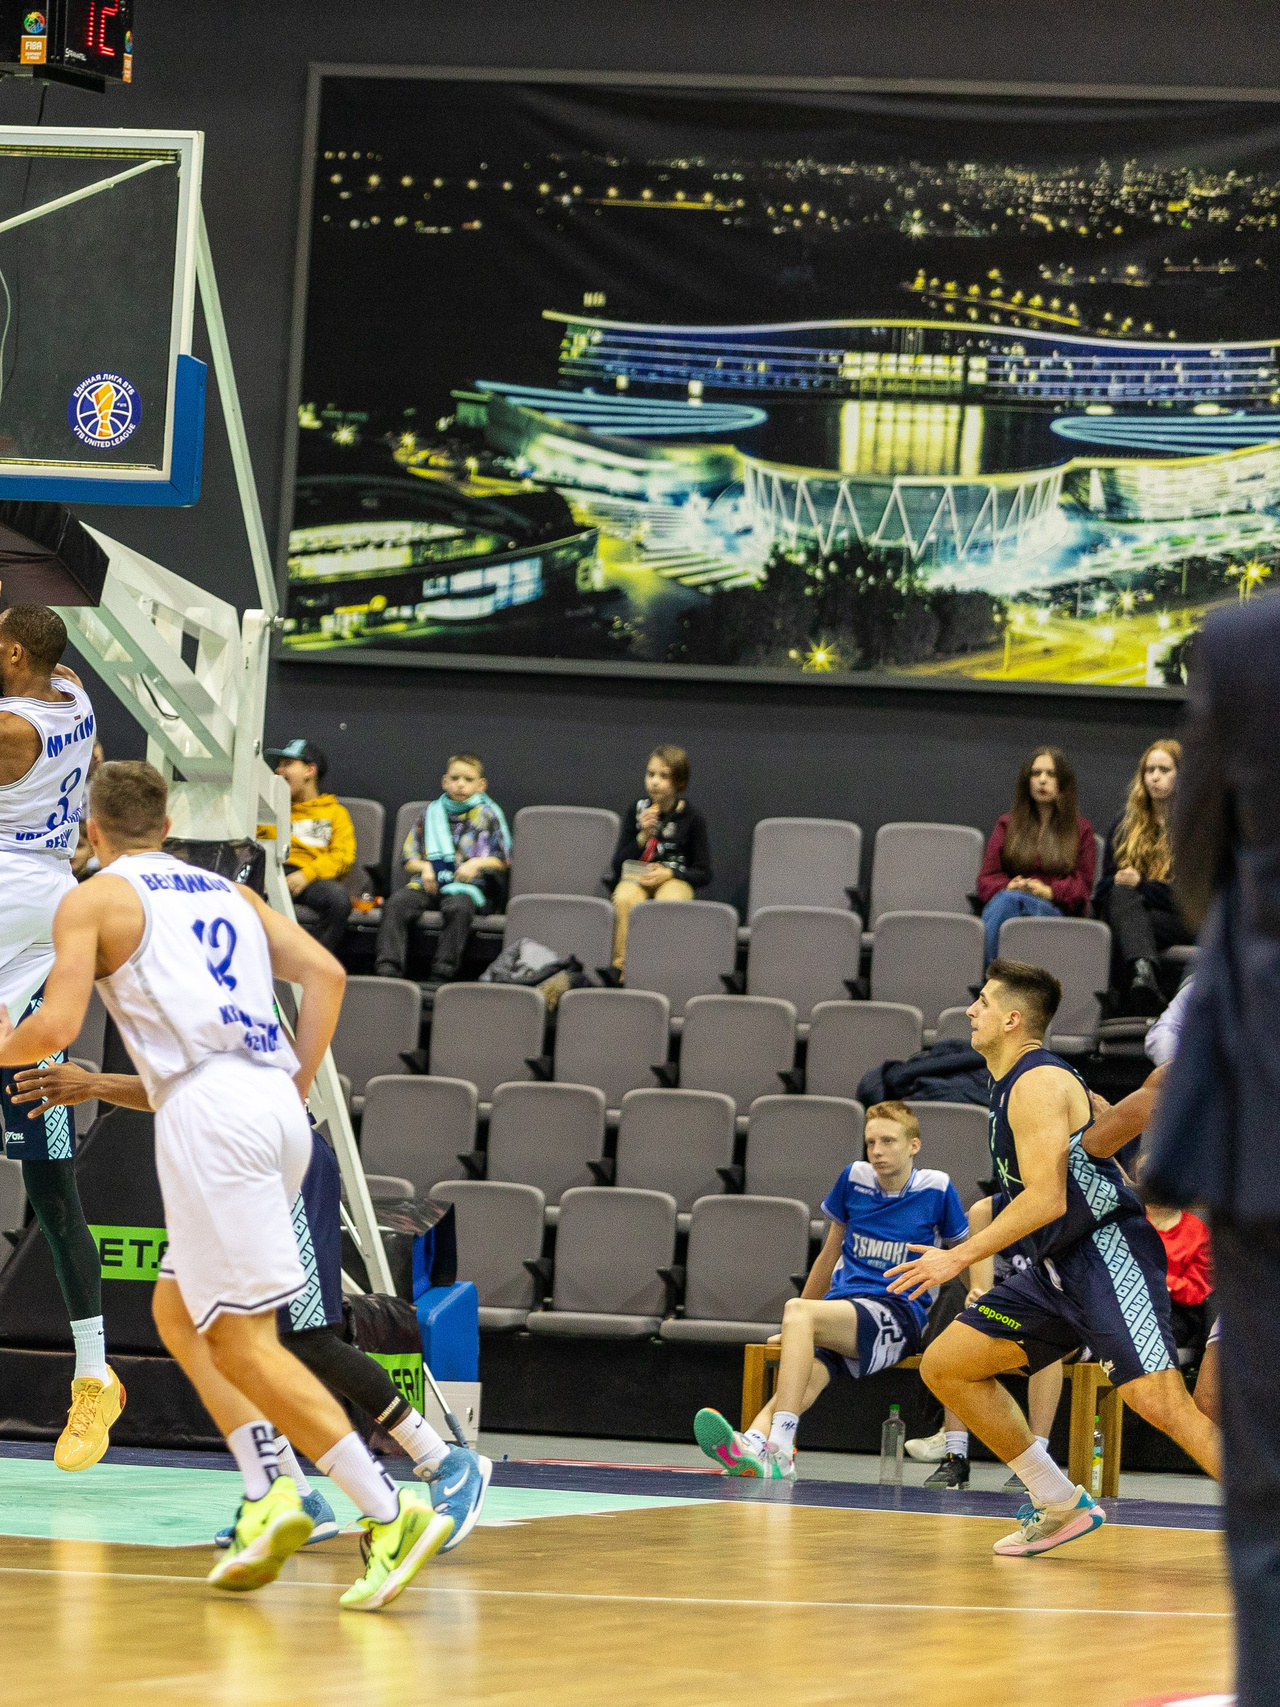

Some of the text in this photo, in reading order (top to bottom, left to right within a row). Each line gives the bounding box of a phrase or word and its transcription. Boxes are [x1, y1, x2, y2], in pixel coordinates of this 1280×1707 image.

[25, 41, 43, 50] FIBA
[73, 373, 135, 398] ЕДИНАЯ ЛИГА ВТБ
[73, 423, 136, 448] VTB UNITED LEAGUE
[46, 767, 82, 831] 3
[978, 1304, 1022, 1330] евроопт
